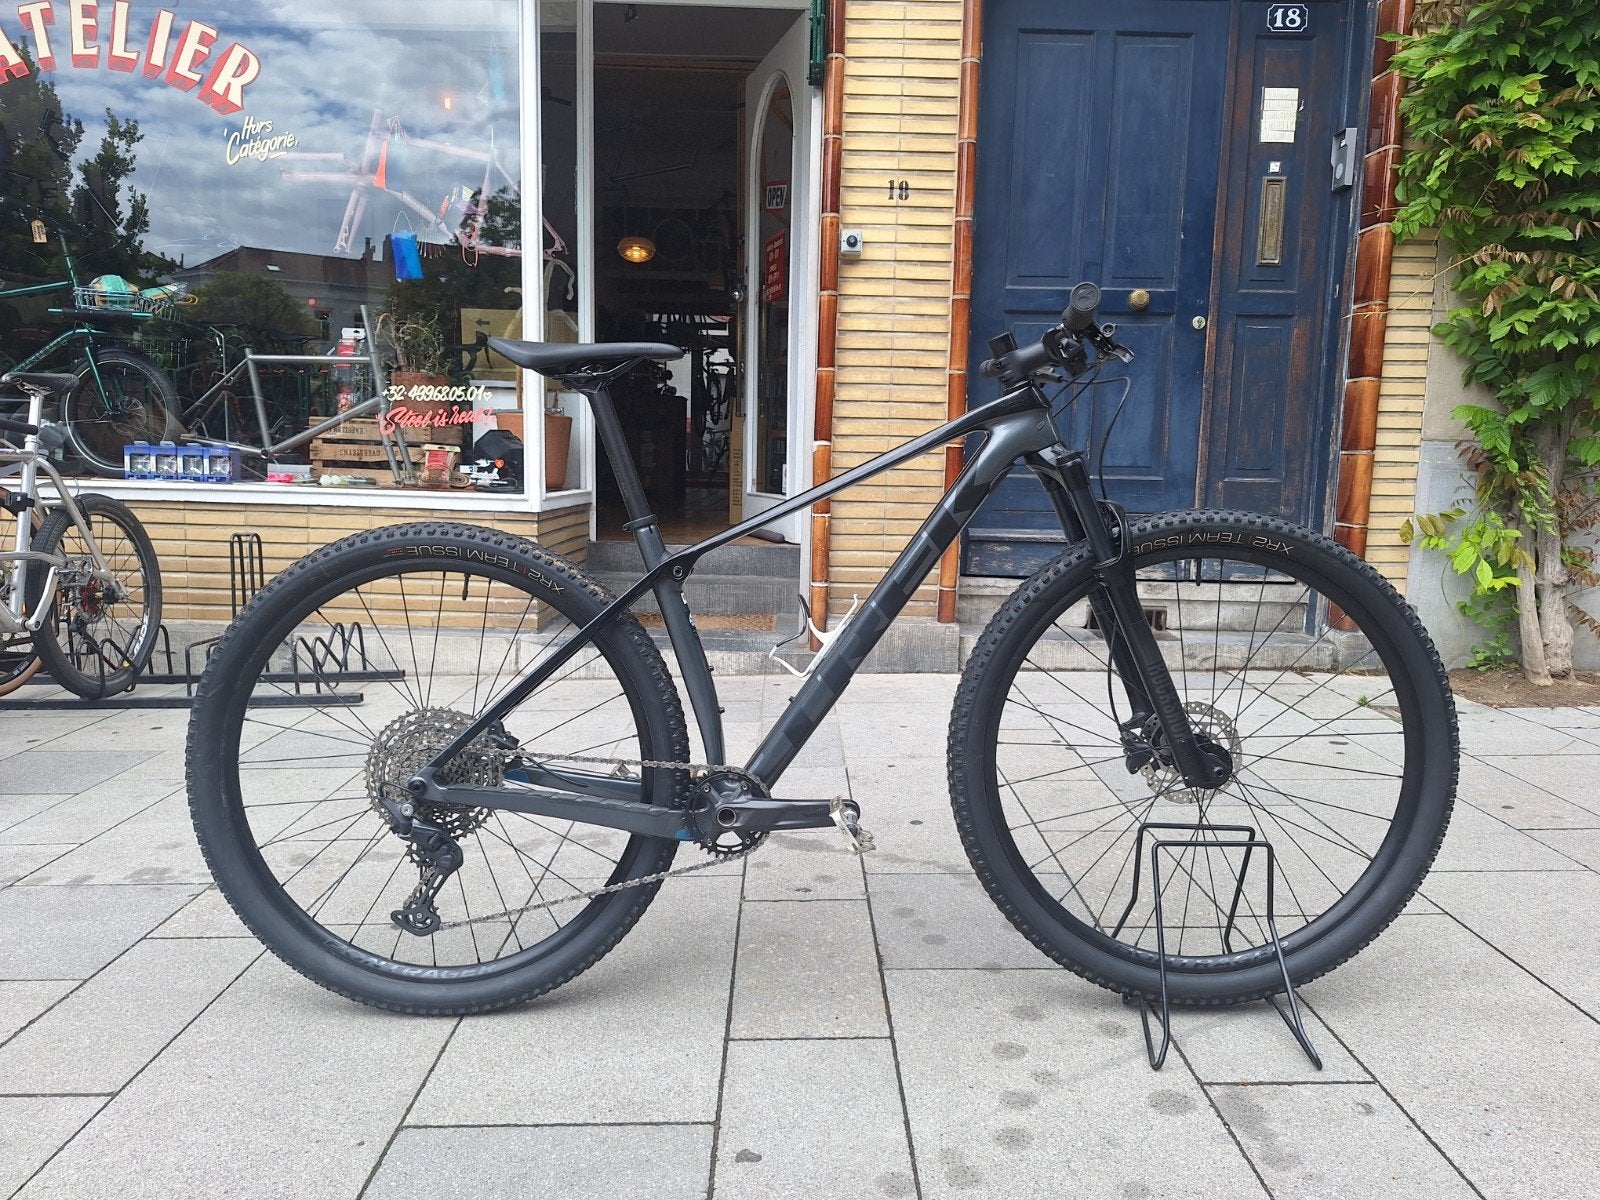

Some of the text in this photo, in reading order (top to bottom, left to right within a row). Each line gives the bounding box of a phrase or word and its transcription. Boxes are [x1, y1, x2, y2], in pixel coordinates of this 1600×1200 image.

[1274, 8, 1301, 28] 18
[241, 115, 273, 140] Hors
[767, 186, 786, 208] OPEN
[1132, 532, 1294, 556] XR2 TEAM ISSUE
[405, 545, 565, 596] XR2 TEAM ISSUE
